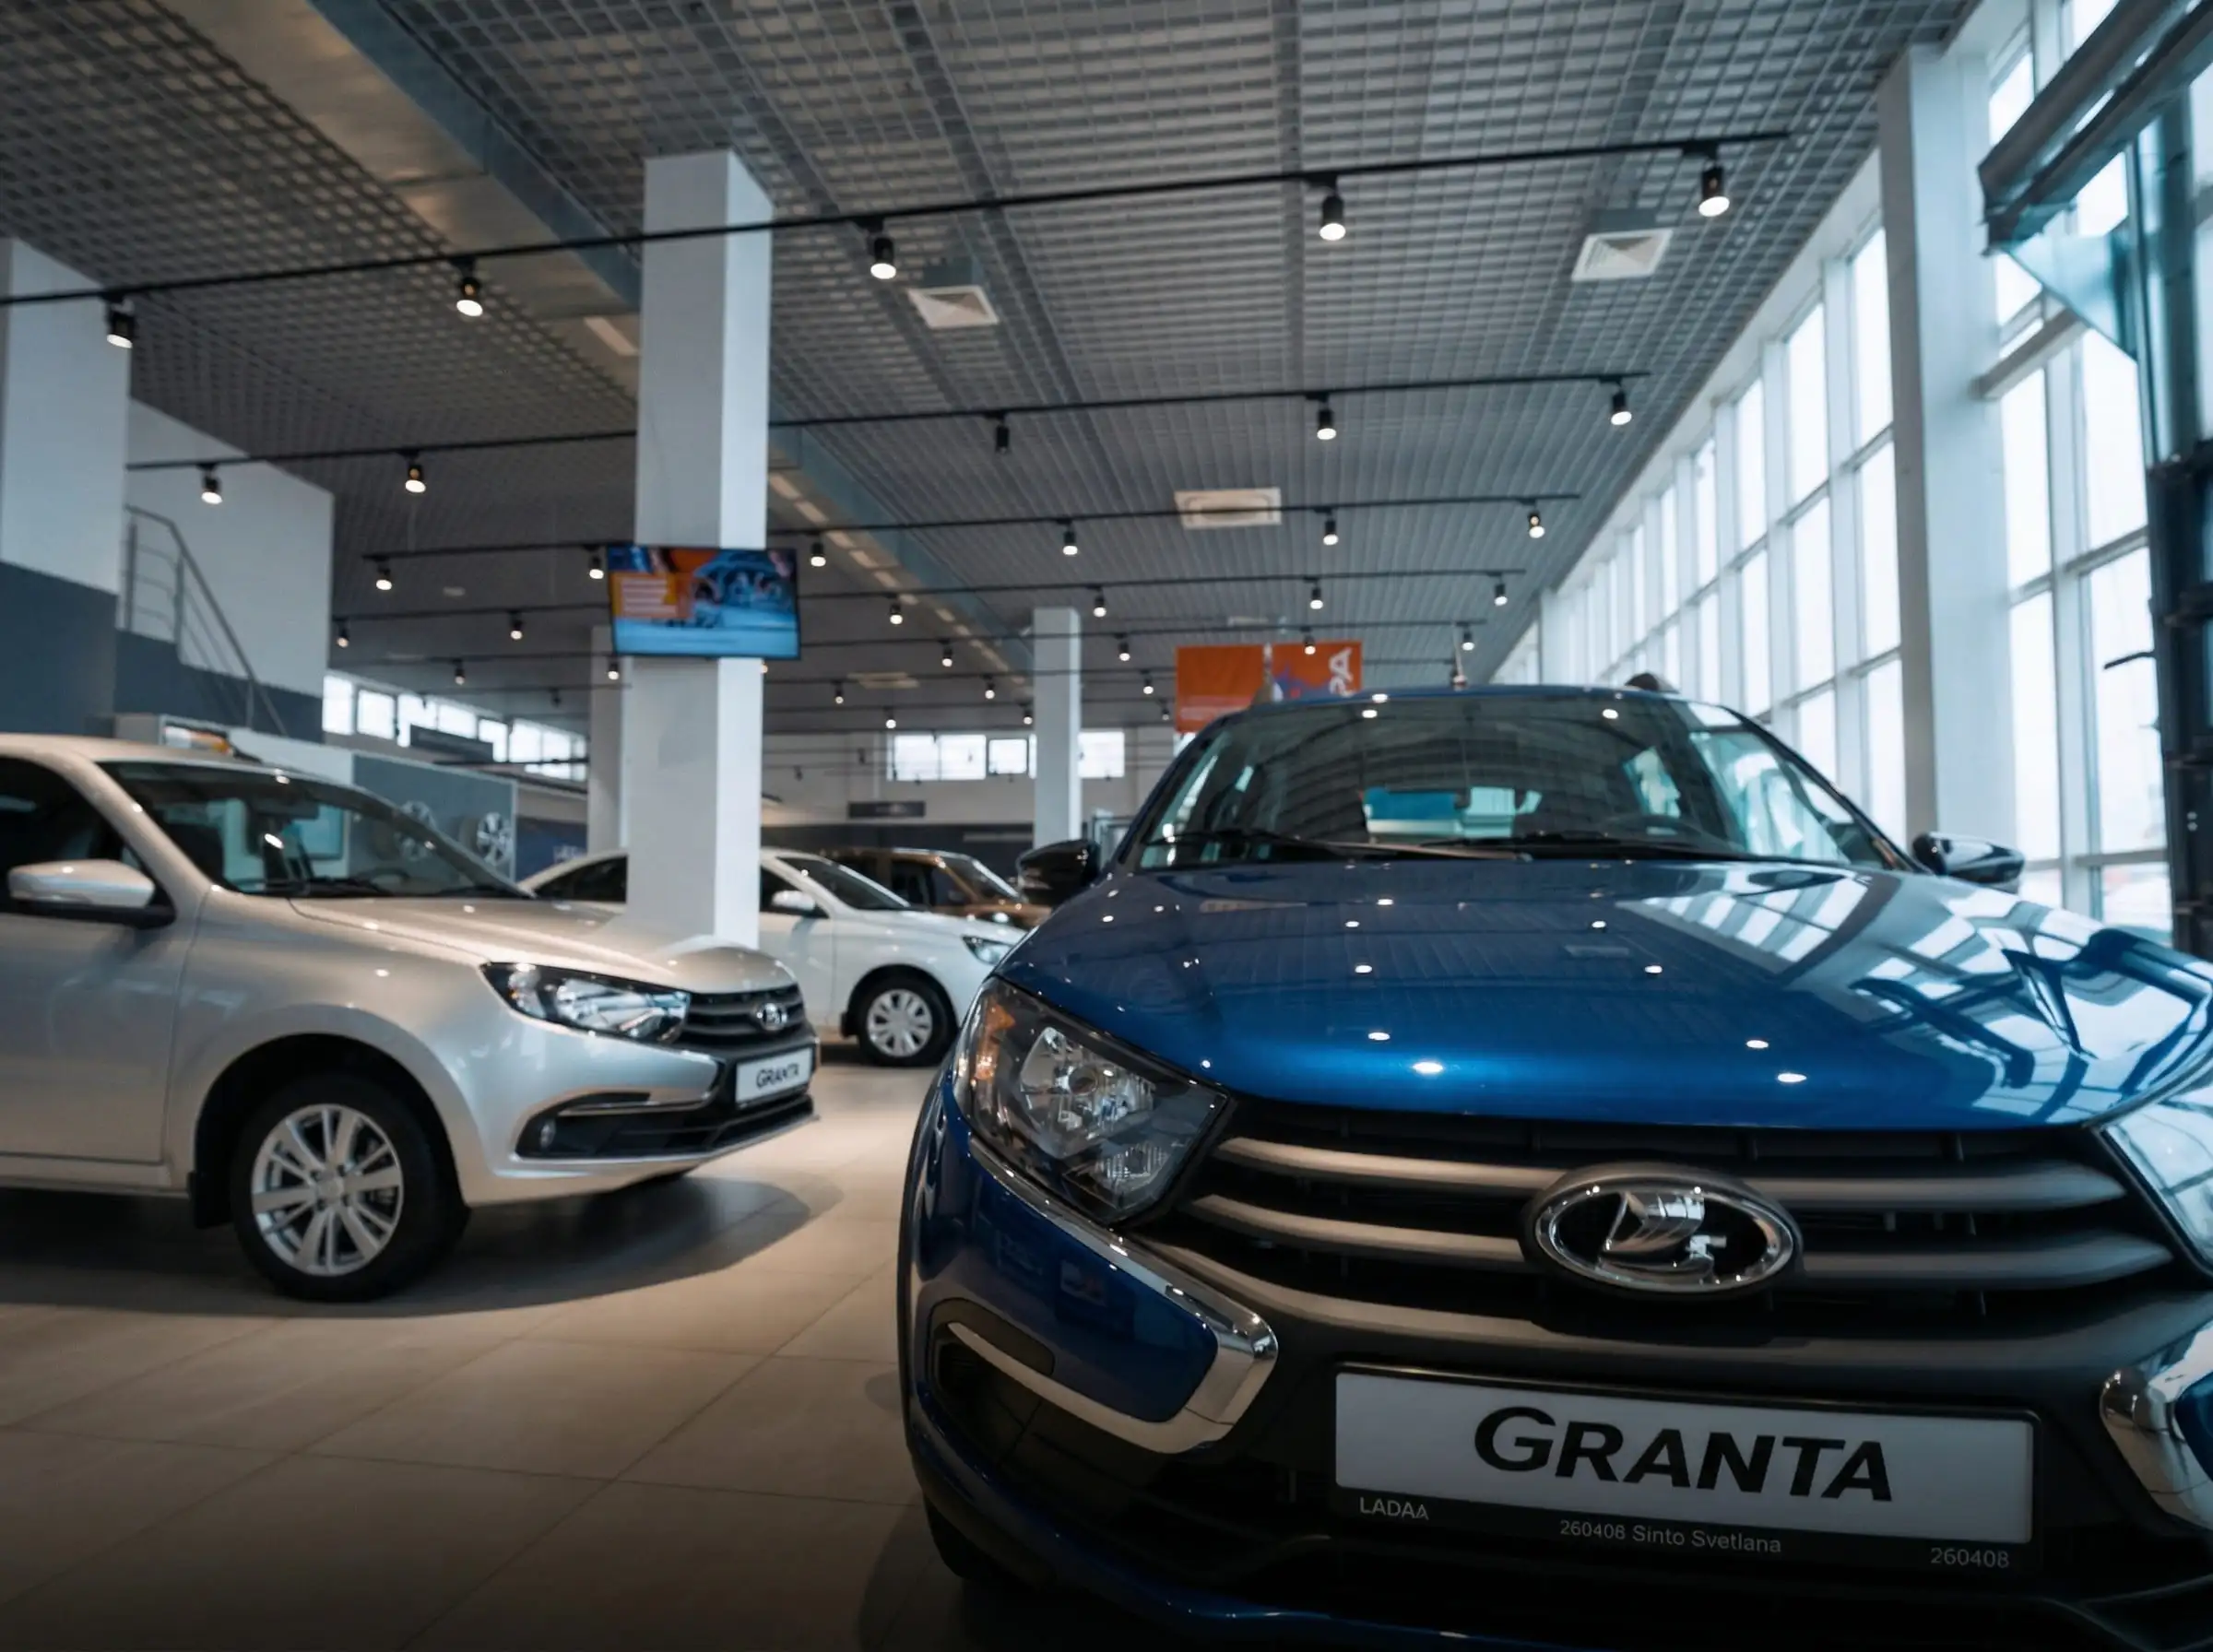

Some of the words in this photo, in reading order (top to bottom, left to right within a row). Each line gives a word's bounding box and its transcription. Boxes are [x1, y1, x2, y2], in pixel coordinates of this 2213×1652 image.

[1473, 1405, 1893, 1502] GRANTA
[1360, 1497, 1429, 1520] LADAA
[1632, 1525, 1685, 1546] Sinto
[1692, 1530, 1781, 1552] Svetlana
[1931, 1547, 2009, 1568] 260408
